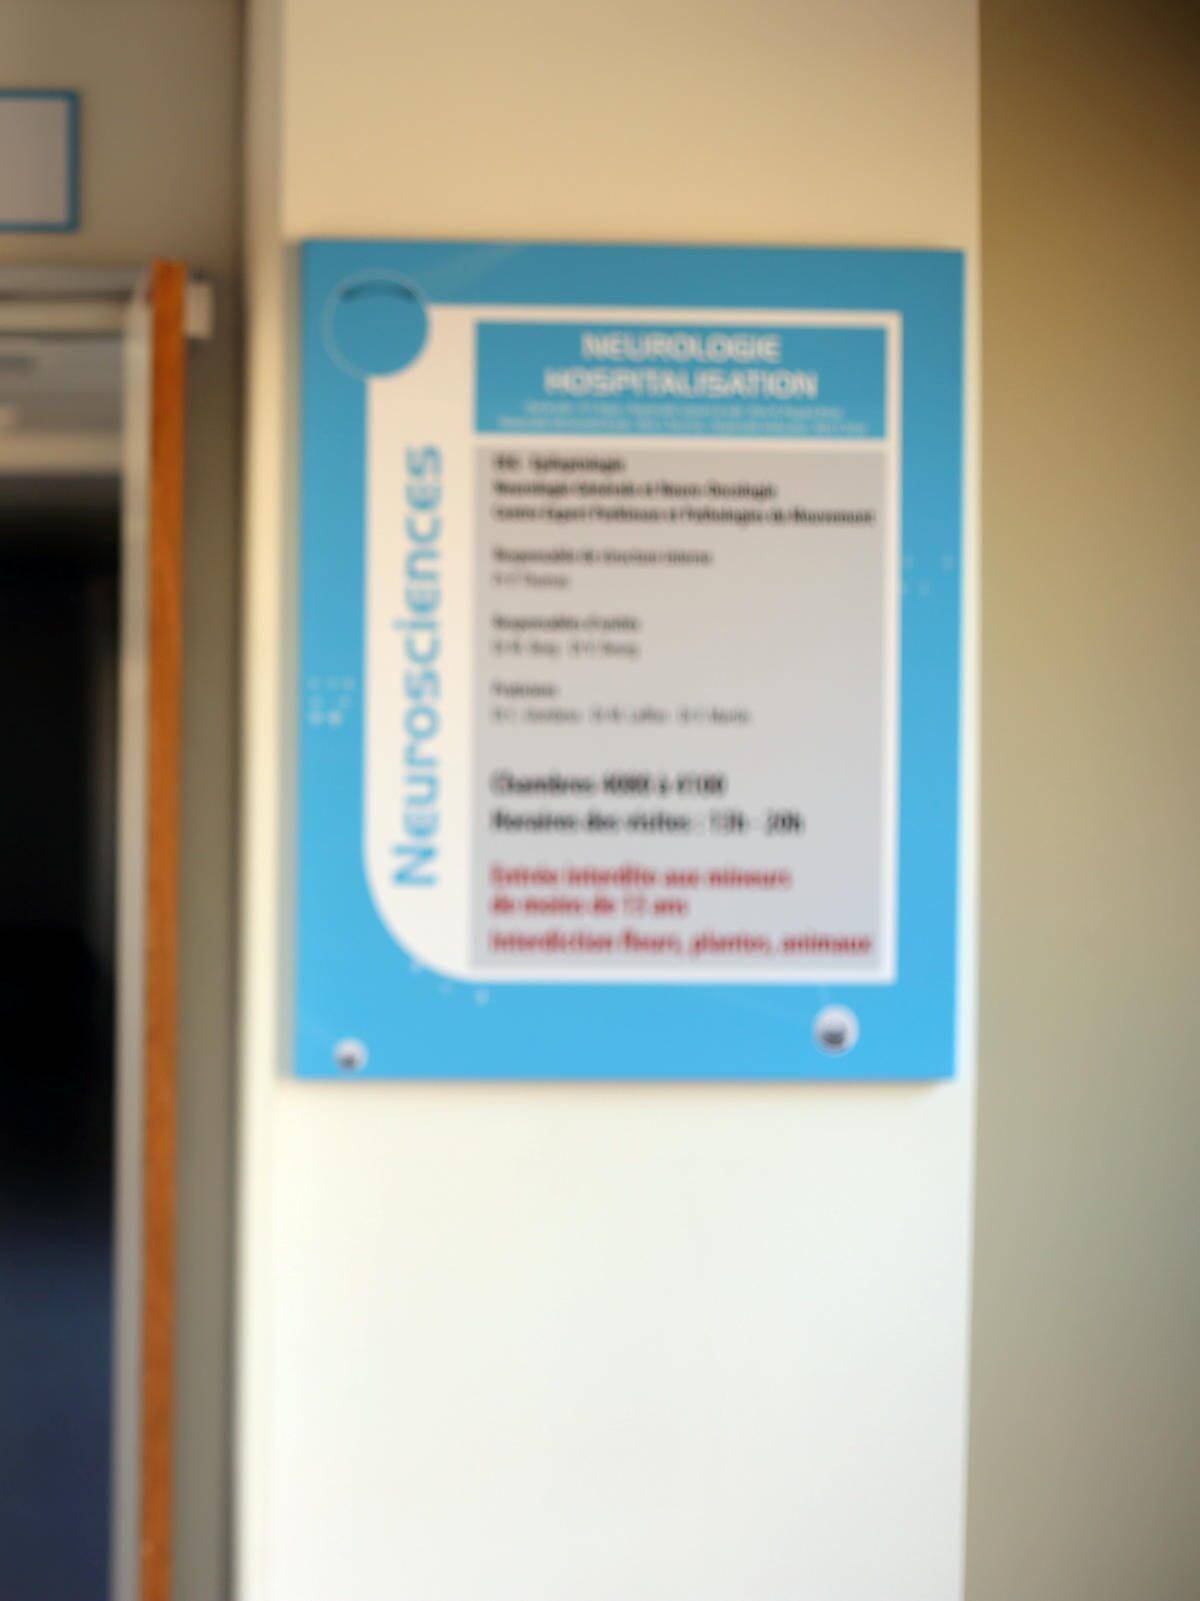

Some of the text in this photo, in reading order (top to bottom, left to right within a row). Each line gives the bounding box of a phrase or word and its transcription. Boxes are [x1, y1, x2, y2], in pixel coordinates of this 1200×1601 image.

[581, 332, 784, 362] NEUROLOGIE
[544, 367, 818, 397] HOSPITALISATION
[392, 444, 444, 886] Neurosciences
[489, 770, 597, 797] Chambres
[490, 807, 582, 834] Horaires
[584, 808, 622, 834] des
[624, 808, 692, 834] visites
[564, 863, 660, 889] interdite
[662, 869, 703, 889] aux
[705, 865, 794, 890] mineurs
[490, 891, 519, 916] de
[521, 892, 587, 916] moins
[589, 892, 618, 916] de
[651, 898, 689, 917] ans
[490, 927, 618, 954] Interdiction
[778, 929, 874, 956] animaux
